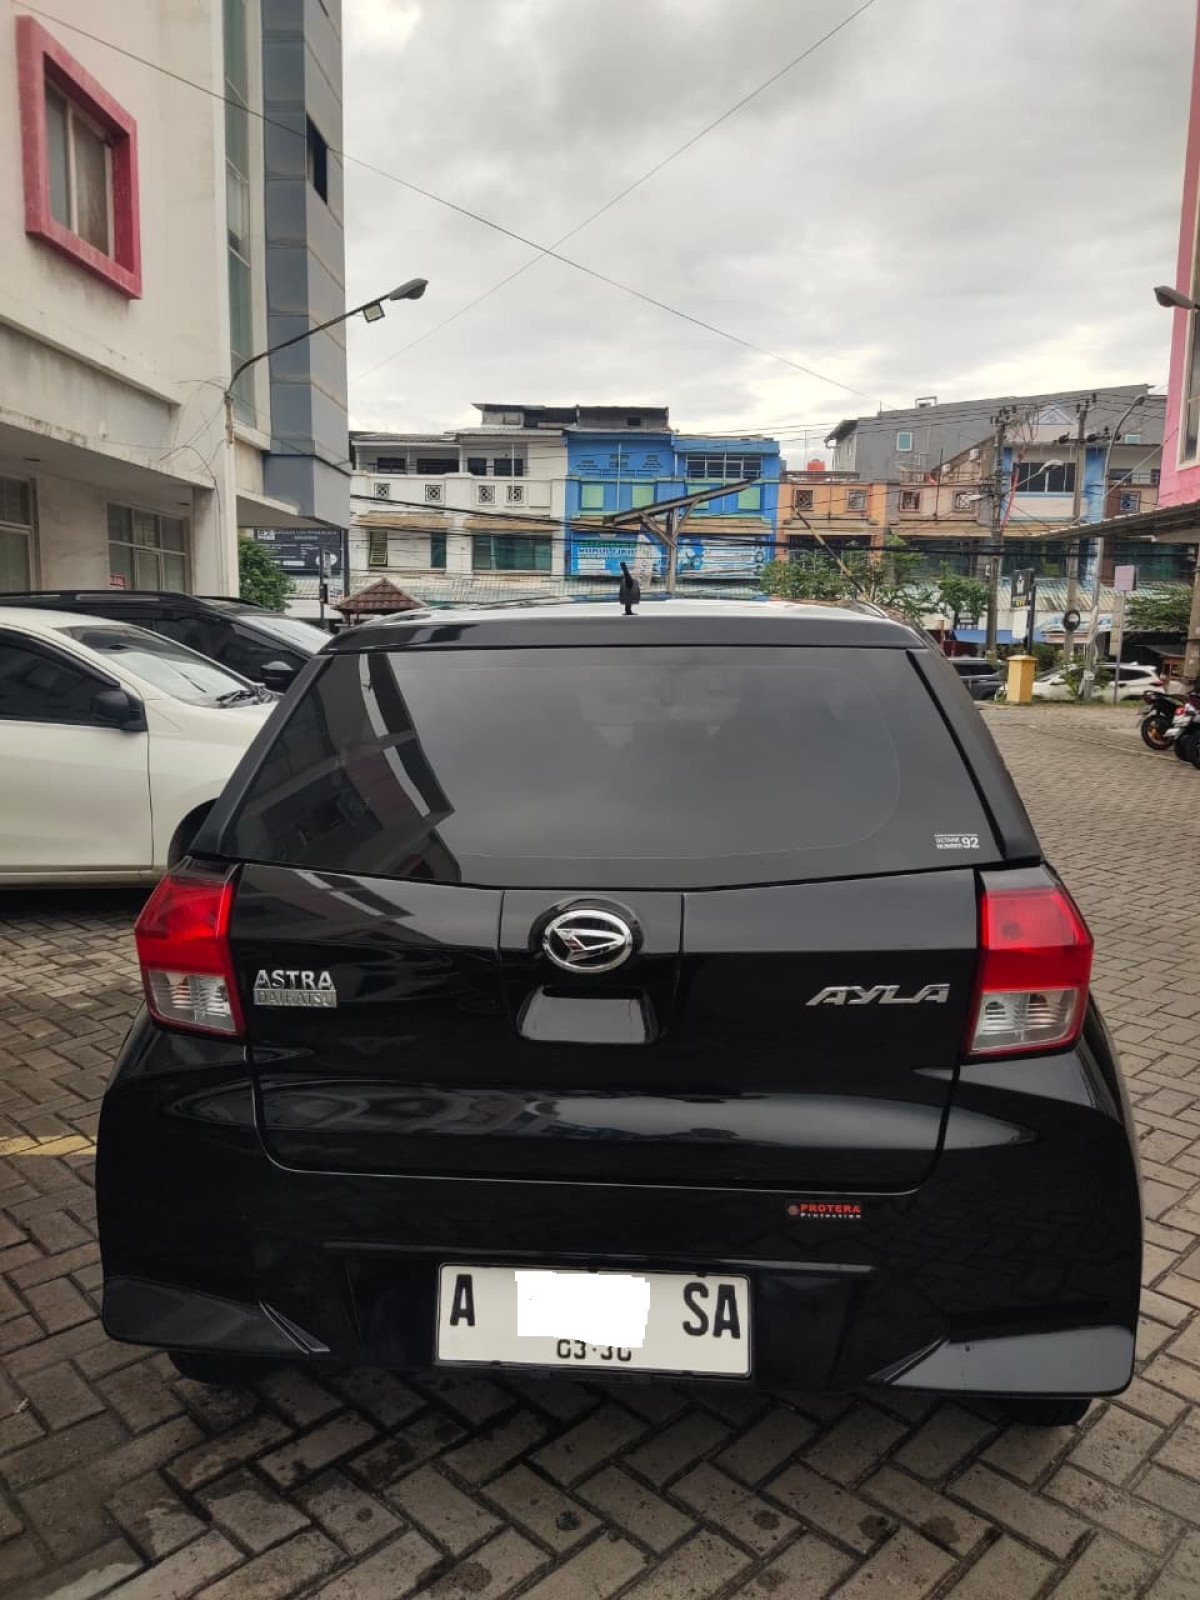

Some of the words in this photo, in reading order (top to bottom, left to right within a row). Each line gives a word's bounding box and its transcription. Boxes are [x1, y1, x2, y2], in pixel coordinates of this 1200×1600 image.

[961, 836, 980, 849] 92
[254, 969, 336, 989] ASTRA
[805, 983, 951, 1006] AYLA
[799, 1203, 861, 1213] PROTERA
[449, 1274, 476, 1327] A
[682, 1281, 741, 1340] SA
